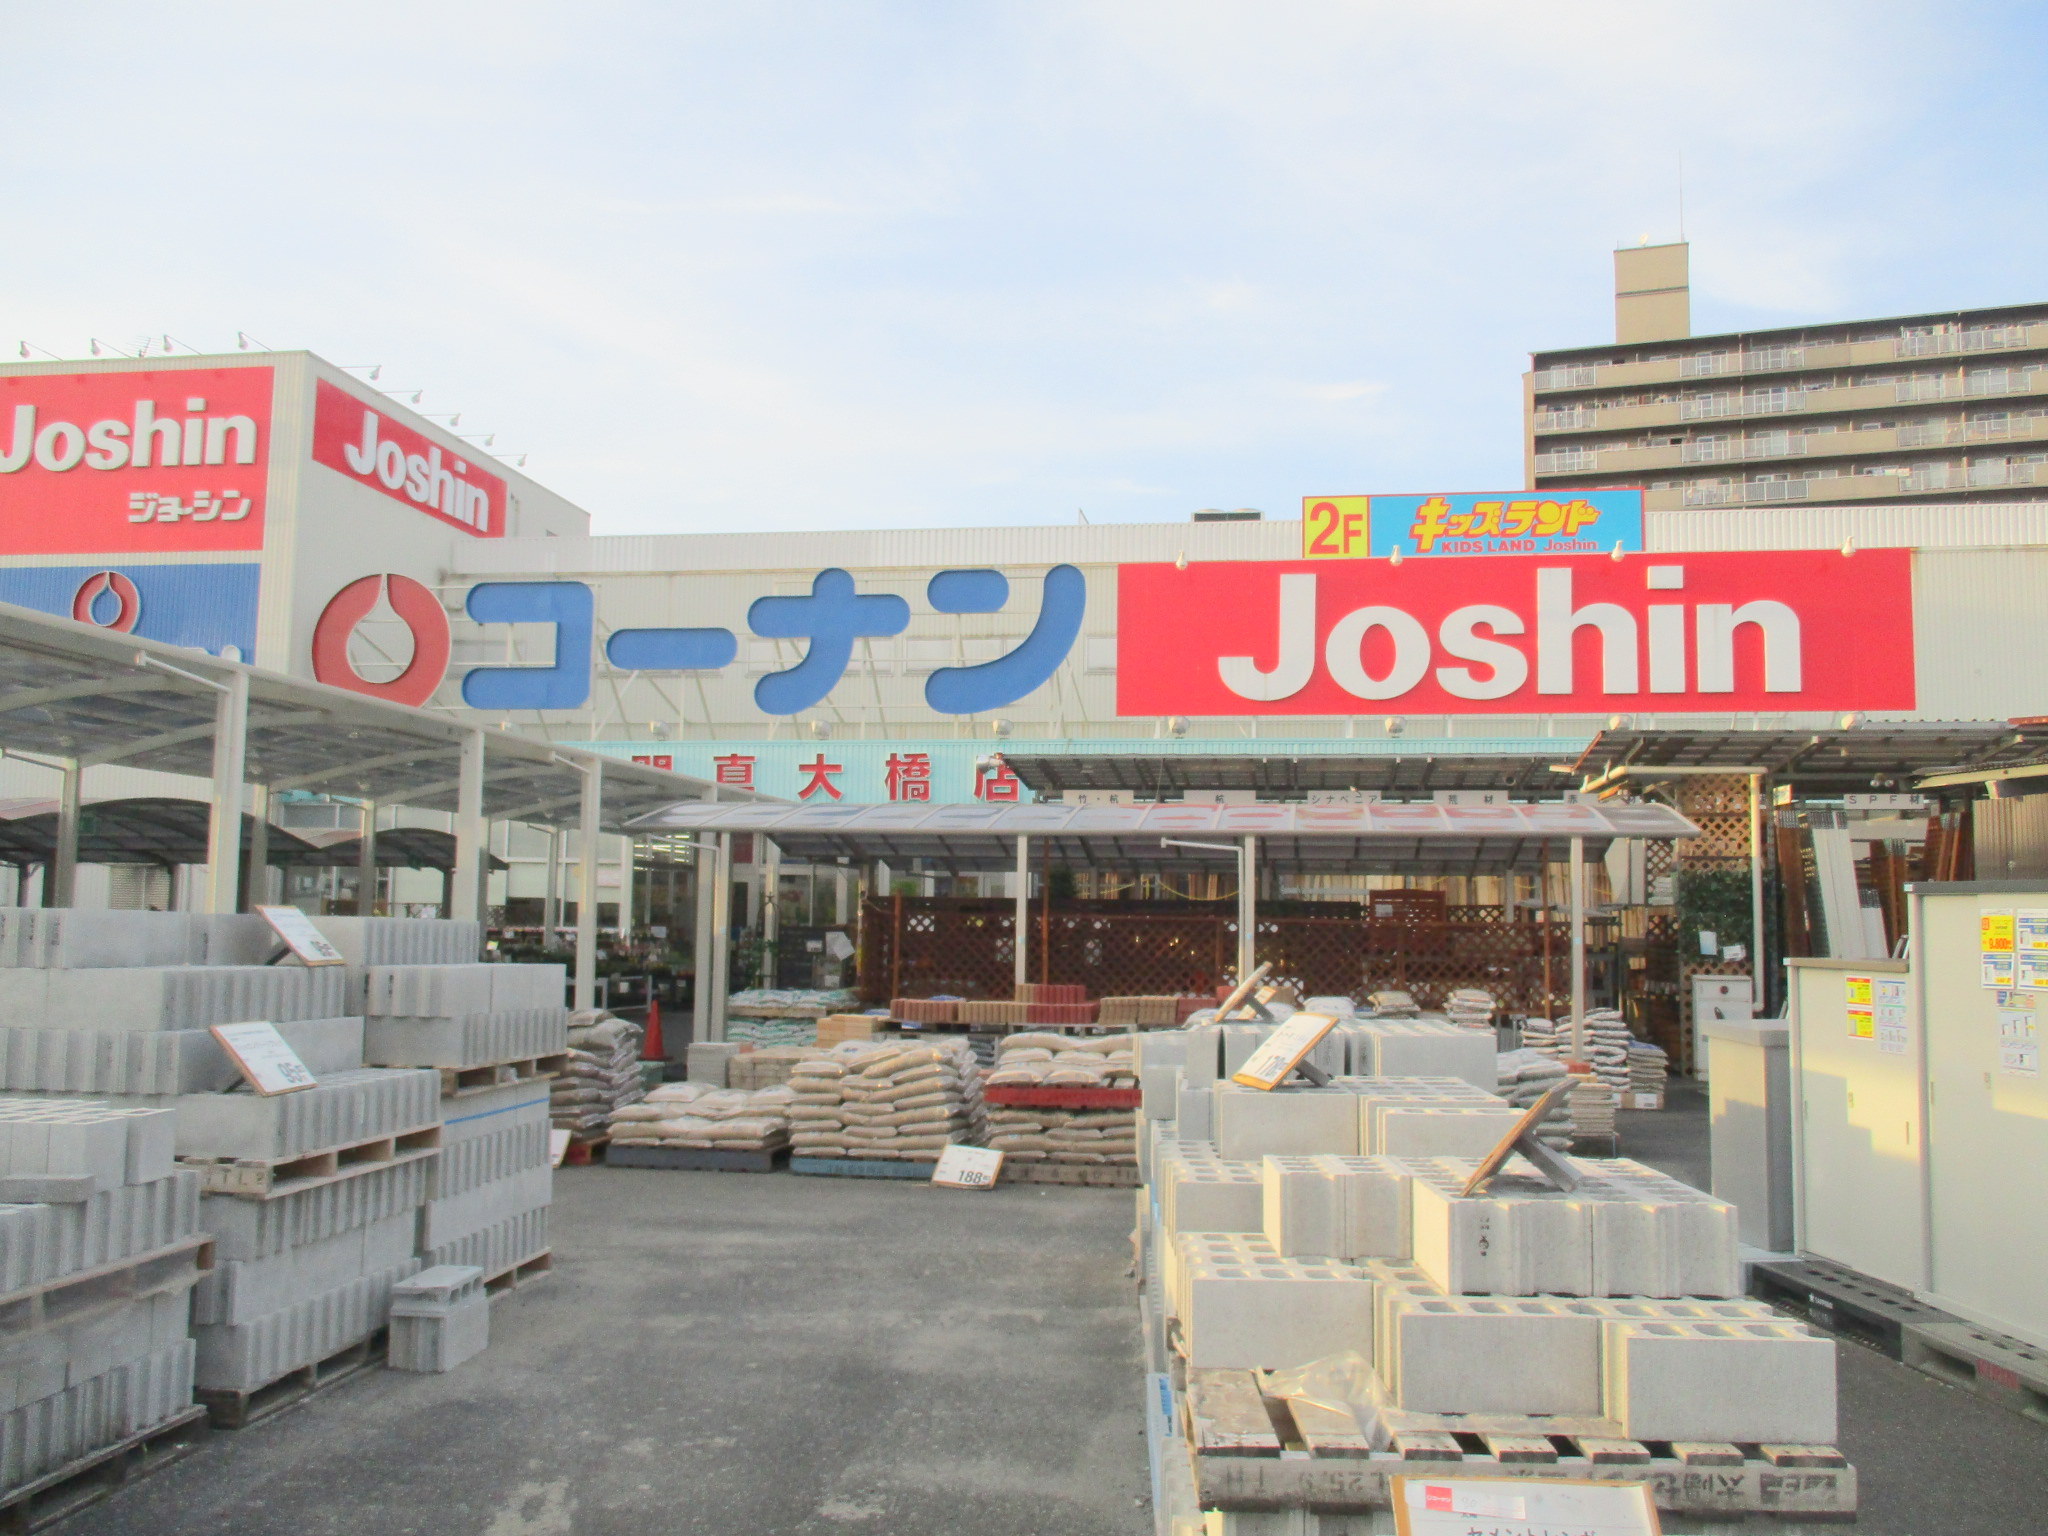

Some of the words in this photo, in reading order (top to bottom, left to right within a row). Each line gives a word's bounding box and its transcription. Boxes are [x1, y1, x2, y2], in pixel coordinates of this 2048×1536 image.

[0, 398, 257, 473] Joshin
[343, 411, 489, 532] Joshin
[128, 490, 252, 523] ジョーシン
[1309, 501, 1363, 554] 2F
[1409, 496, 1602, 554] キッズランド
[1441, 539, 1483, 553] KIDS
[1487, 539, 1536, 552] LAND
[1543, 538, 1598, 551] Joshin
[465, 563, 1087, 716] コーナン
[1218, 565, 1802, 701] Joshin
[959, 1170, 983, 1184] 188
